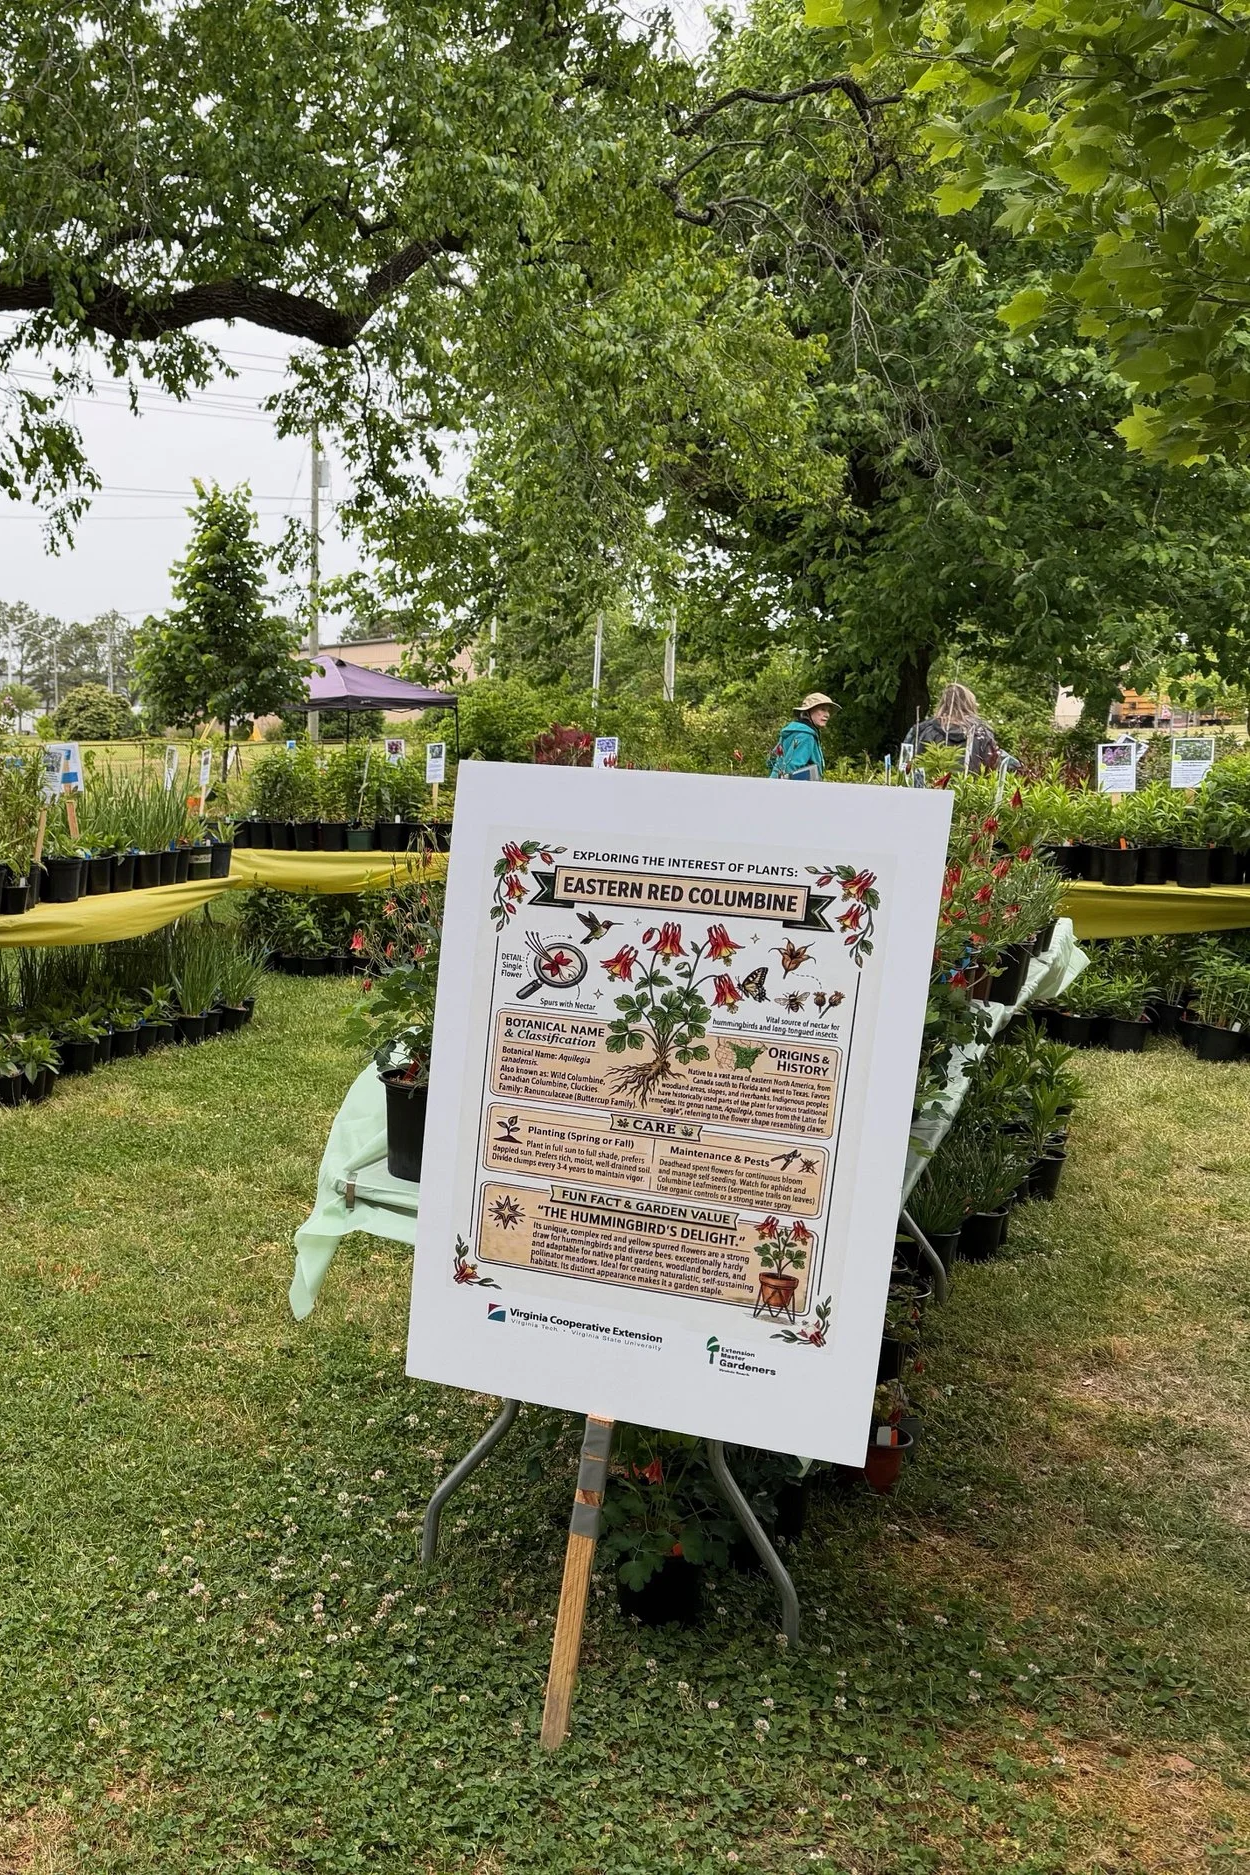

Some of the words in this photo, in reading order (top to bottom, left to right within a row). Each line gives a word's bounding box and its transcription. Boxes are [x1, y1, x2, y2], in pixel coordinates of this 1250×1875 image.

[572, 850, 639, 864] EXPLORING
[641, 855, 665, 866] THE
[667, 857, 725, 871] INTEREST
[727, 862, 744, 872] OF
[746, 864, 798, 877] PLANTS:
[563, 876, 643, 899] EASTERN
[647, 883, 684, 902] RED
[688, 886, 798, 912] COLUMBINE
[501, 952, 525, 962] DETAIL:
[501, 960, 522, 970] Single
[500, 968, 522, 978] Flower
[539, 997, 558, 1006] Spurs
[558, 1000, 573, 1008] with
[574, 1001, 596, 1010] Nectar
[505, 1016, 567, 1033] BOTANICAL
[570, 1024, 605, 1037] NAME
[765, 1015, 780, 1024] Vital
[802, 1019, 810, 1027] of
[830, 1022, 840, 1031] for
[503, 1027, 514, 1037] &
[517, 1029, 596, 1047] Classification
[501, 1045, 534, 1057] Botanical
[534, 1049, 557, 1059] Name:
[557, 1053, 590, 1064] Aquilegia
[768, 1046, 820, 1063] ORIGINS
[821, 1056, 830, 1064] &
[499, 1064, 514, 1073] Also
[515, 1065, 538, 1076] known
[550, 1070, 566, 1080] Wild
[566, 1072, 605, 1086] Columbine,
[776, 1059, 829, 1077] HISTORY
[499, 1073, 530, 1084] Canadian
[530, 1077, 569, 1090] Columbine,
[498, 1082, 523, 1094] Family:
[523, 1085, 573, 1100] Ranunculaceae
[573, 1092, 610, 1105] (Buttercup
[527, 1125, 566, 1140] Planting
[567, 1131, 600, 1145] (Spring
[602, 1137, 613, 1145] or
[614, 1138, 634, 1149] Fall)
[632, 1119, 676, 1134] CARE
[492, 1143, 519, 1154] dappled
[534, 1149, 558, 1160] Prefers
[558, 1153, 573, 1163] rich,
[573, 1157, 594, 1167] moist,
[526, 1139, 543, 1149] Plant
[544, 1142, 551, 1150] in
[551, 1143, 563, 1152] full
[585, 1147, 597, 1157] full
[597, 1150, 620, 1162] shade,
[620, 1154, 645, 1164] prefers
[669, 1145, 732, 1162] Maintenance
[733, 1154, 741, 1163] &
[743, 1155, 769, 1167] Pests
[491, 1152, 513, 1162] Divide
[513, 1155, 537, 1167] clumps
[537, 1160, 556, 1170] every
[556, 1161, 567, 1170] 3-4
[568, 1165, 586, 1174] years
[586, 1167, 594, 1175] to
[594, 1169, 625, 1179] maintain
[625, 1173, 645, 1182] vigor.
[561, 1189, 587, 1202] FUN
[590, 1194, 622, 1207] FACT
[623, 1199, 632, 1209] &
[635, 1201, 687, 1218] GARDEN
[690, 1209, 730, 1224] VALUE
[532, 1230, 550, 1239] draw
[550, 1232, 561, 1241] for
[561, 1234, 612, 1250] hummingbirds
[612, 1244, 627, 1252] and
[627, 1245, 653, 1257] diverse
[674, 1254, 722, 1269] exceptionally
[722, 1260, 743, 1272] hardy
[533, 1221, 542, 1229] Its
[542, 1223, 569, 1235] unique,
[570, 1228, 599, 1239] complex
[600, 1233, 612, 1241] red
[613, 1235, 627, 1243] and
[627, 1237, 651, 1247] yellow
[651, 1241, 680, 1252] spurred
[680, 1244, 706, 1256] flowers
[707, 1250, 719, 1258] are
[725, 1253, 750, 1264] strong
[530, 1248, 564, 1260] pollinator
[564, 1254, 599, 1266] meadows.
[600, 1259, 618, 1269] Ideal
[618, 1262, 629, 1271] for
[629, 1265, 659, 1277] creating
[659, 1270, 701, 1284] naturalistic,
[701, 1277, 754, 1293] self-sustaining
[531, 1240, 545, 1248] and
[545, 1242, 580, 1254] adaptable
[581, 1246, 591, 1255] for
[591, 1250, 613, 1260] native
[614, 1253, 633, 1263] plant
[633, 1257, 664, 1268] gardens,
[665, 1262, 701, 1273] woodland
[701, 1266, 731, 1279] borders,
[731, 1273, 746, 1281] and
[509, 1307, 548, 1322] Virginia
[549, 1315, 611, 1334] Cooperative
[612, 1326, 662, 1343] Extension
[510, 1318, 538, 1328] Virginia
[540, 1323, 558, 1332] Tech
[570, 1329, 599, 1339] Virginia
[602, 1335, 621, 1343] State
[624, 1339, 661, 1351] University
[720, 1346, 755, 1357] Extension
[720, 1352, 745, 1361] Master
[719, 1358, 776, 1375] Gardeners
